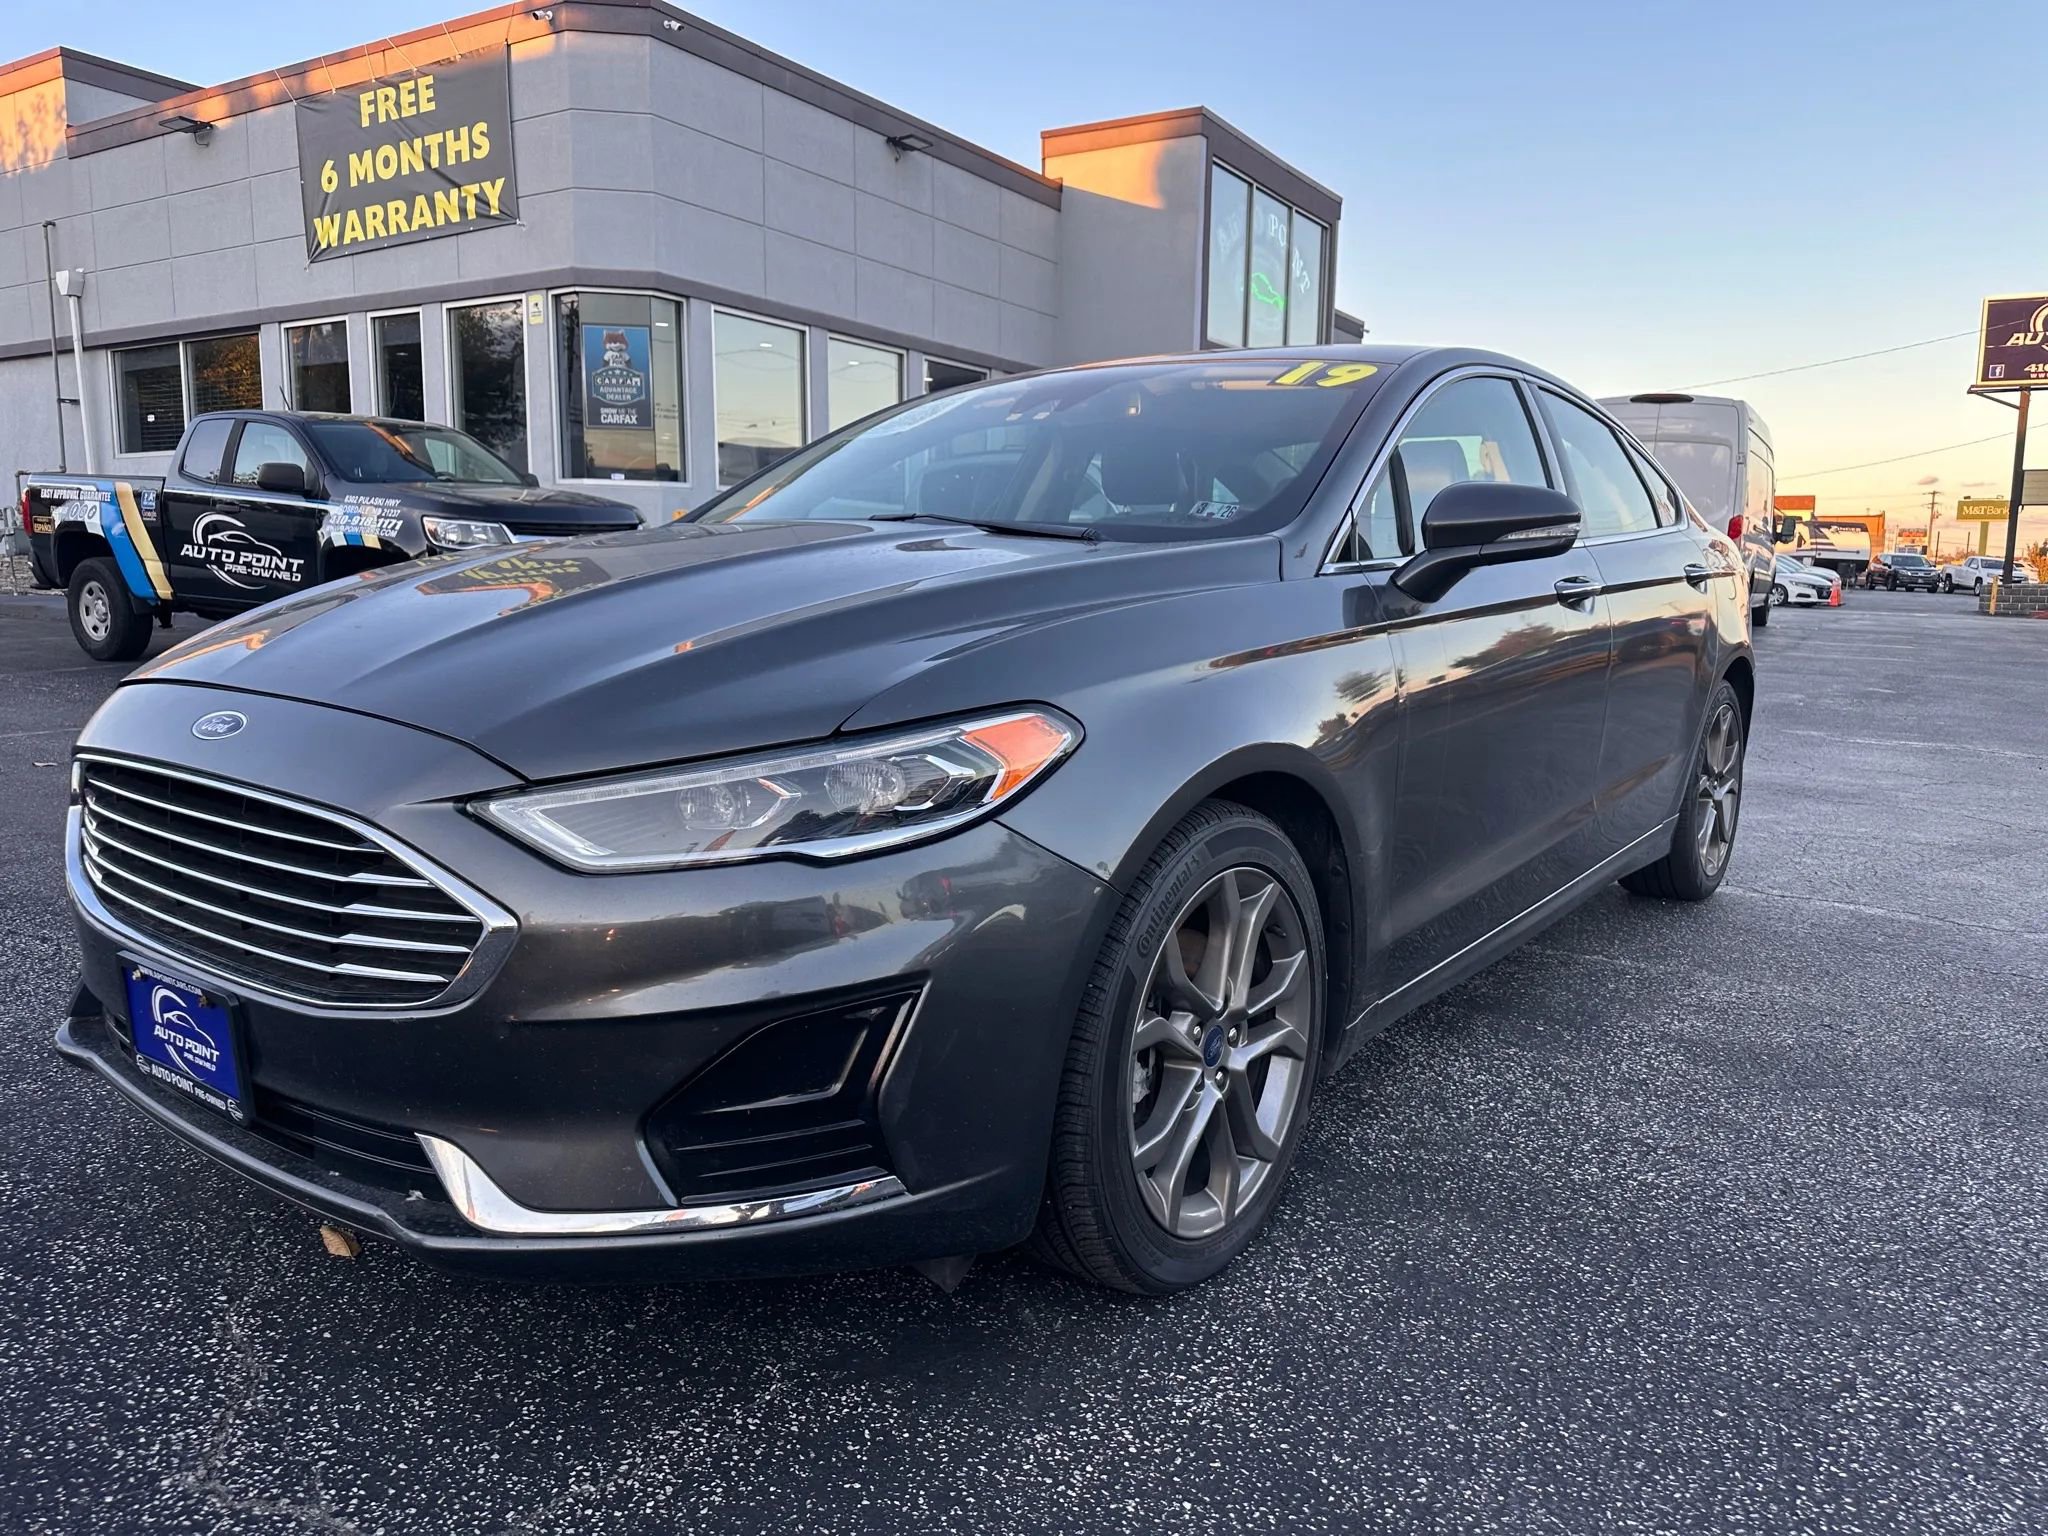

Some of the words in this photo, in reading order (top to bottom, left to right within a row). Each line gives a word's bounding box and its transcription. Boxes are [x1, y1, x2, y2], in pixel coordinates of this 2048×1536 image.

[359, 74, 436, 128] FREE
[320, 159, 339, 193] 6
[348, 121, 491, 188] MONTHS
[313, 177, 506, 249] WARRANTY
[2005, 331, 2048, 346] AU
[1275, 361, 1378, 387] 19
[599, 386, 637, 394] ADVANTAGE
[606, 393, 632, 401] DEALER
[600, 414, 638, 424] CARFAX
[40, 489, 54, 499] EASY
[53, 488, 79, 500] APPROVAL
[80, 490, 111, 502] GUARANTEE
[359, 496, 385, 506] PULASKI
[385, 498, 402, 507] HWY
[382, 509, 401, 517] 21237
[1962, 505, 1987, 515] M&T
[329, 514, 404, 529] 410-918-1171
[180, 543, 236, 563] AUTO
[238, 551, 305, 572] POINT
[224, 563, 302, 582] PRE-OWNED
[1136, 865, 1193, 959] Continental
[153, 1024, 184, 1047] AUTO
[185, 1037, 220, 1062] POINT
[151, 1063, 172, 1083] AUTO
[171, 1072, 194, 1094] POINT
[194, 1086, 227, 1111] PRE-OWNED
